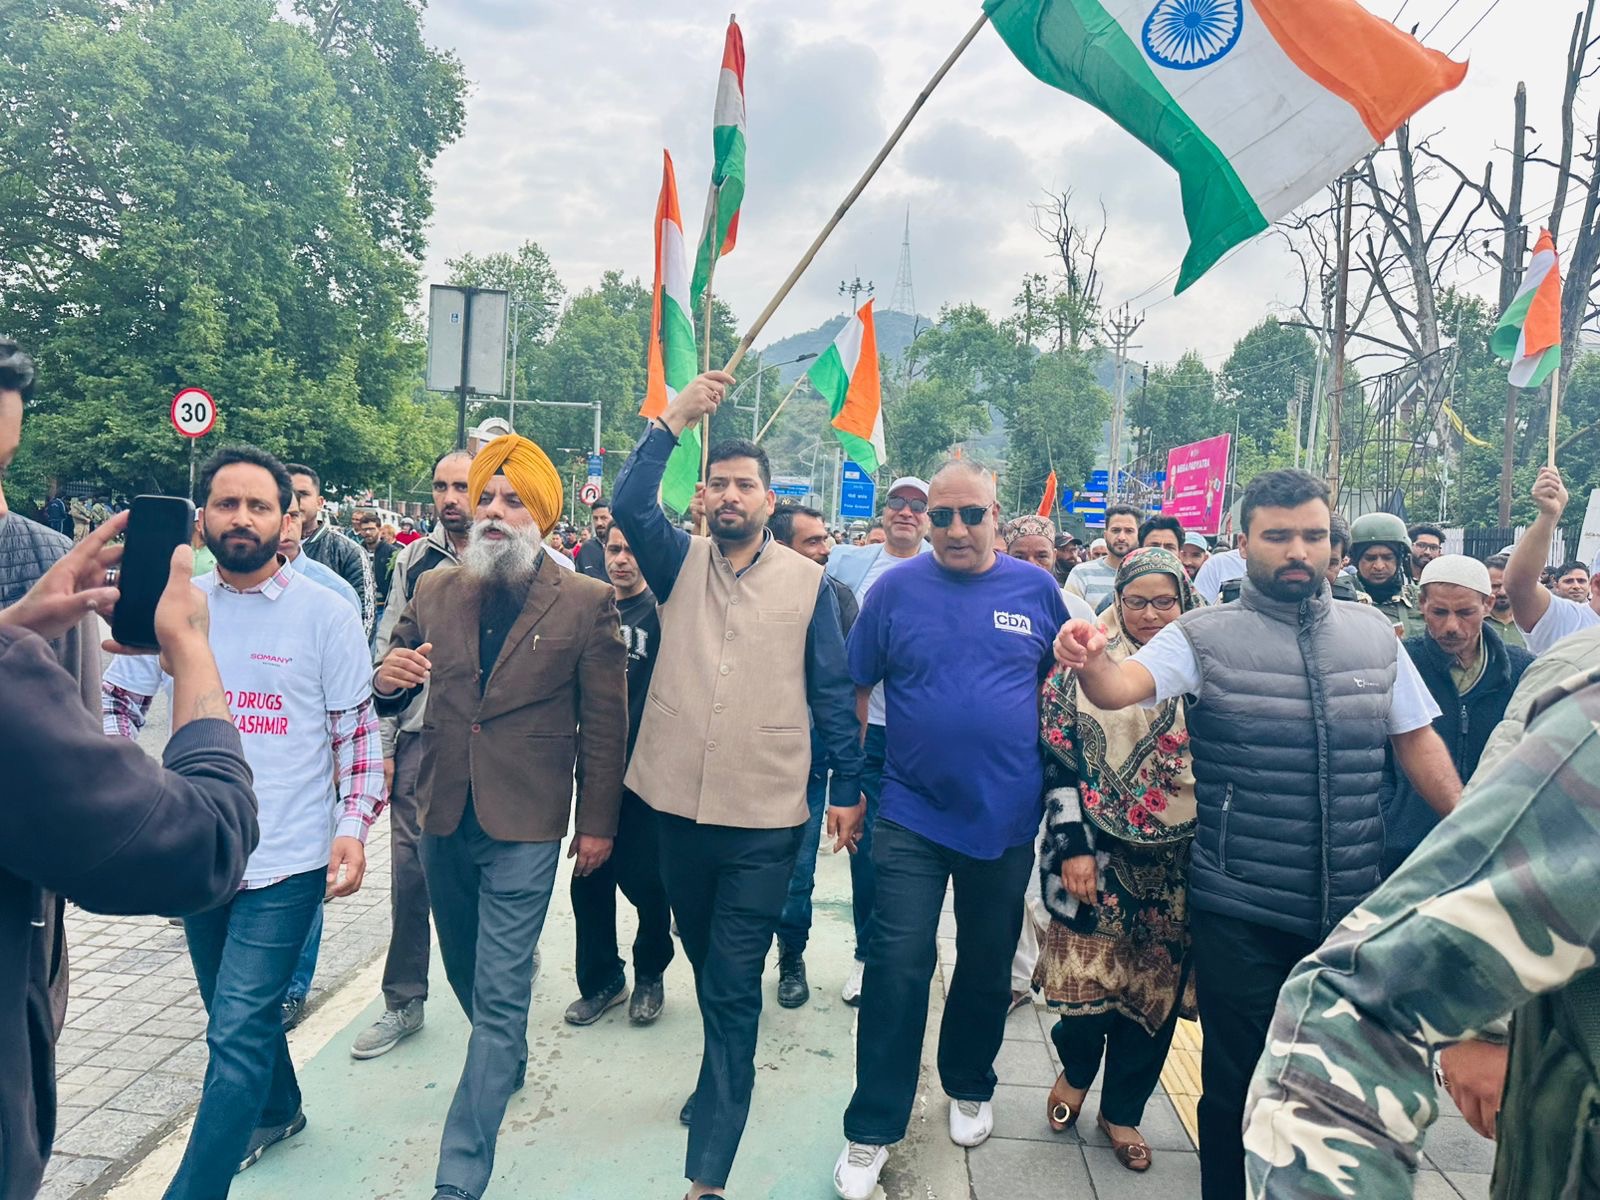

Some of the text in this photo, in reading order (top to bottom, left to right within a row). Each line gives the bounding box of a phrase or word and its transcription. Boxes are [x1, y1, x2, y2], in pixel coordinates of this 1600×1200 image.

[181, 402, 206, 422] 30
[996, 614, 1028, 630] CDA
[250, 653, 291, 664] SOMANY
[224, 691, 283, 710] O DRUGS
